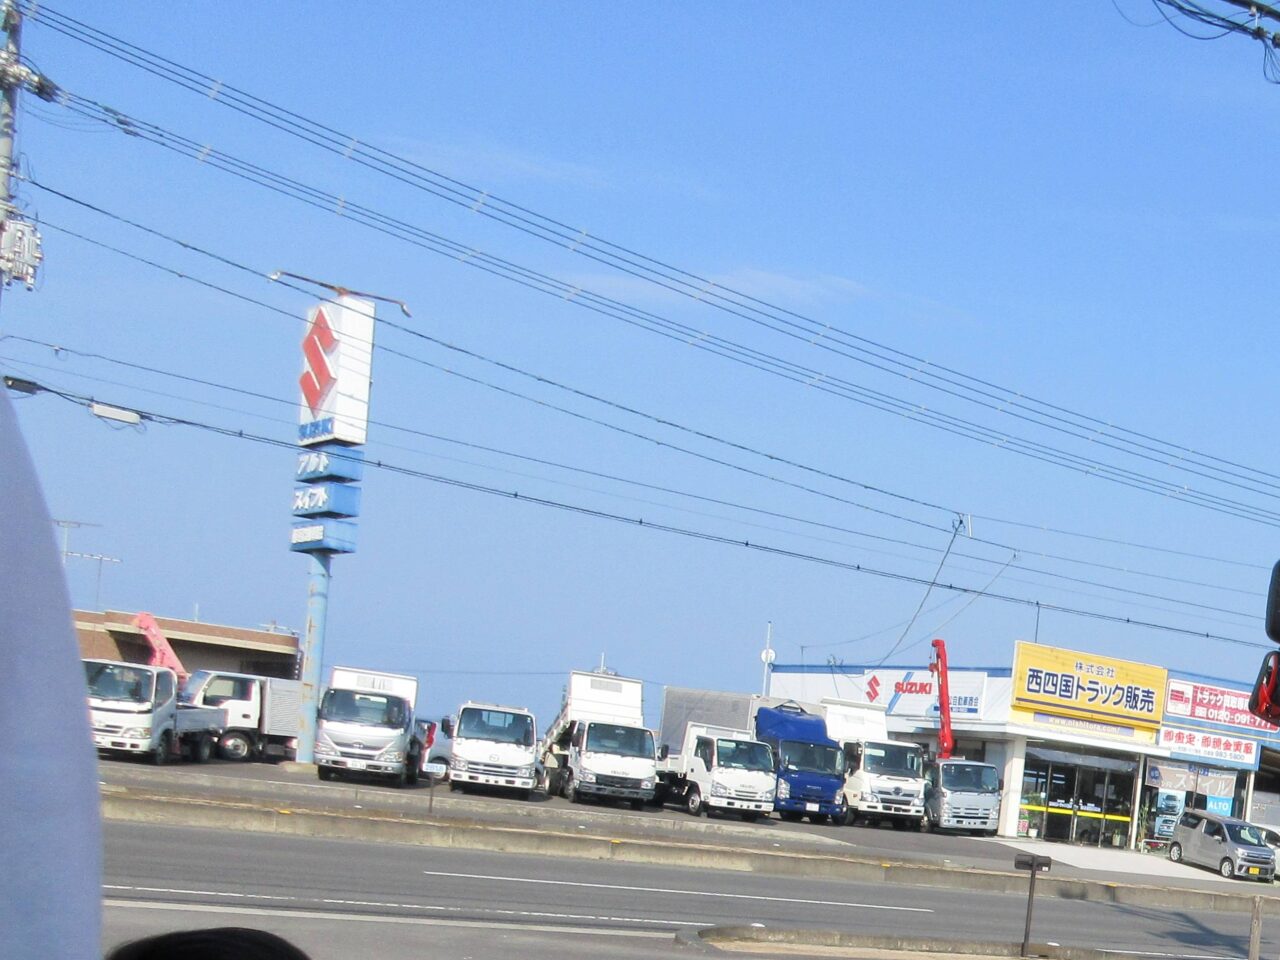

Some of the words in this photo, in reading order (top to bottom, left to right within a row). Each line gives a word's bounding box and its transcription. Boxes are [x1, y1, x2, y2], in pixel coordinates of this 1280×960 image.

[298, 452, 329, 475] アルト
[1075, 661, 1116, 678] 株式会社
[894, 681, 933, 695] SUZUKI
[1027, 667, 1156, 714] 西四国トラック販売
[1208, 800, 1230, 811] ALTO
